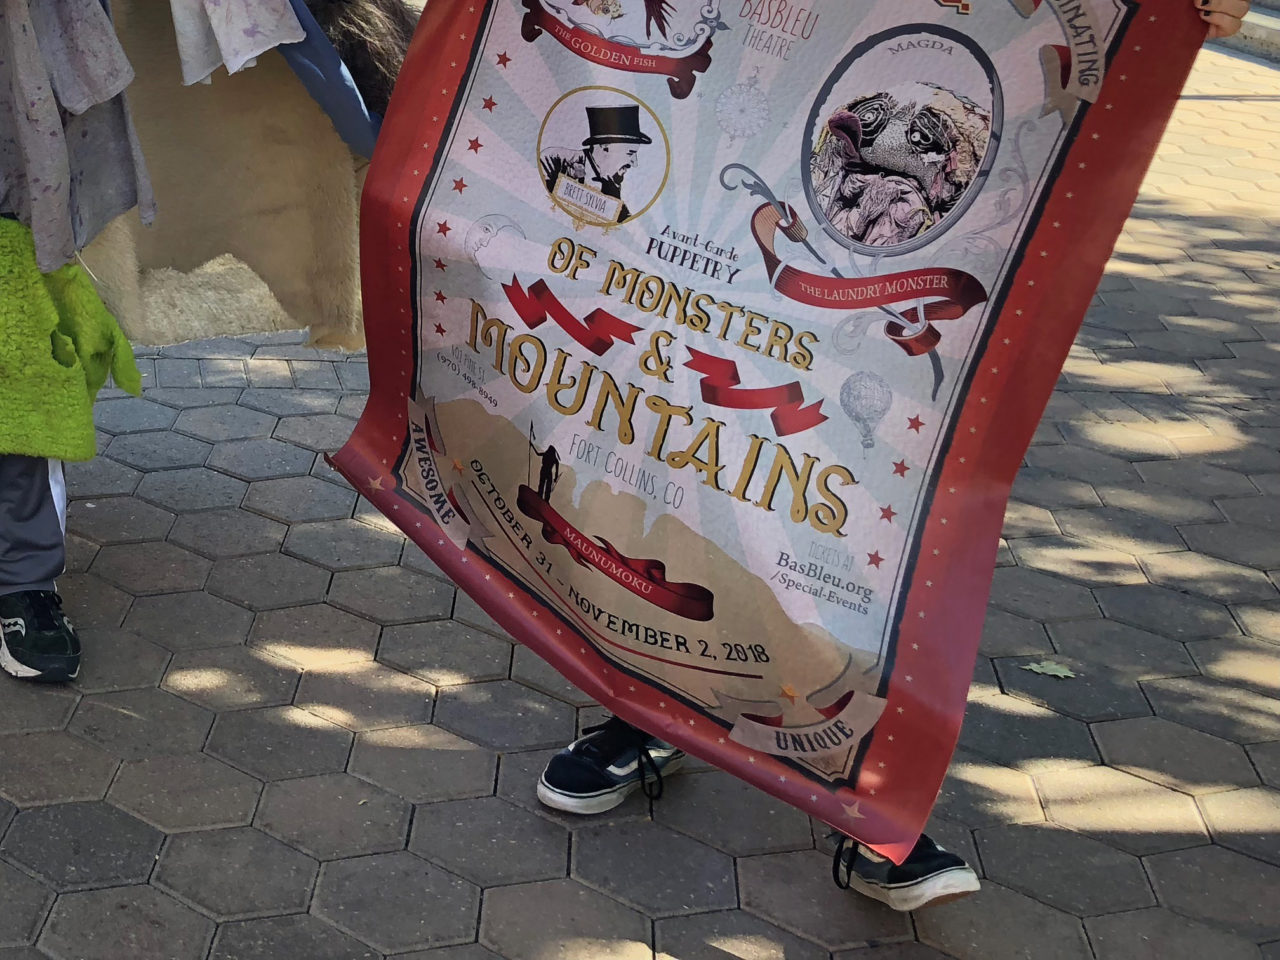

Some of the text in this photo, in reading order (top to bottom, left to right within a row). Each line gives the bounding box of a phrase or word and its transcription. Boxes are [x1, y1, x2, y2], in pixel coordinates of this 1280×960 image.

[554, 24, 656, 68] THE GOLDEN FISH
[742, 23, 797, 61] THEATRE
[887, 39, 955, 56] MAGDA
[563, 182, 607, 213] BRETT SYLVIA
[645, 236, 742, 285] PUPPETRY
[660, 224, 740, 262] Avant-Garde
[547, 237, 821, 372] OF MONSTERS
[799, 275, 949, 301] THE LAUNDRY MONSTER
[436, 351, 498, 408] (970) 498-8949
[638, 329, 677, 384] &
[465, 297, 860, 539] MOUNTAINS
[411, 420, 456, 525] AWESOME
[569, 433, 684, 509] FORT COLLINS, CO
[470, 459, 533, 551] OCTOBER
[535, 550, 553, 576] 31
[568, 583, 691, 654] NOVEMBER
[697, 640, 718, 661] 2,
[720, 642, 770, 664] 2018
[565, 527, 653, 594] MAUNUMOKU
[776, 551, 875, 604] BasBleu.org
[808, 541, 841, 568] TICKETS
[770, 570, 869, 616] /Special-Events
[775, 719, 854, 753] UNIQUE
